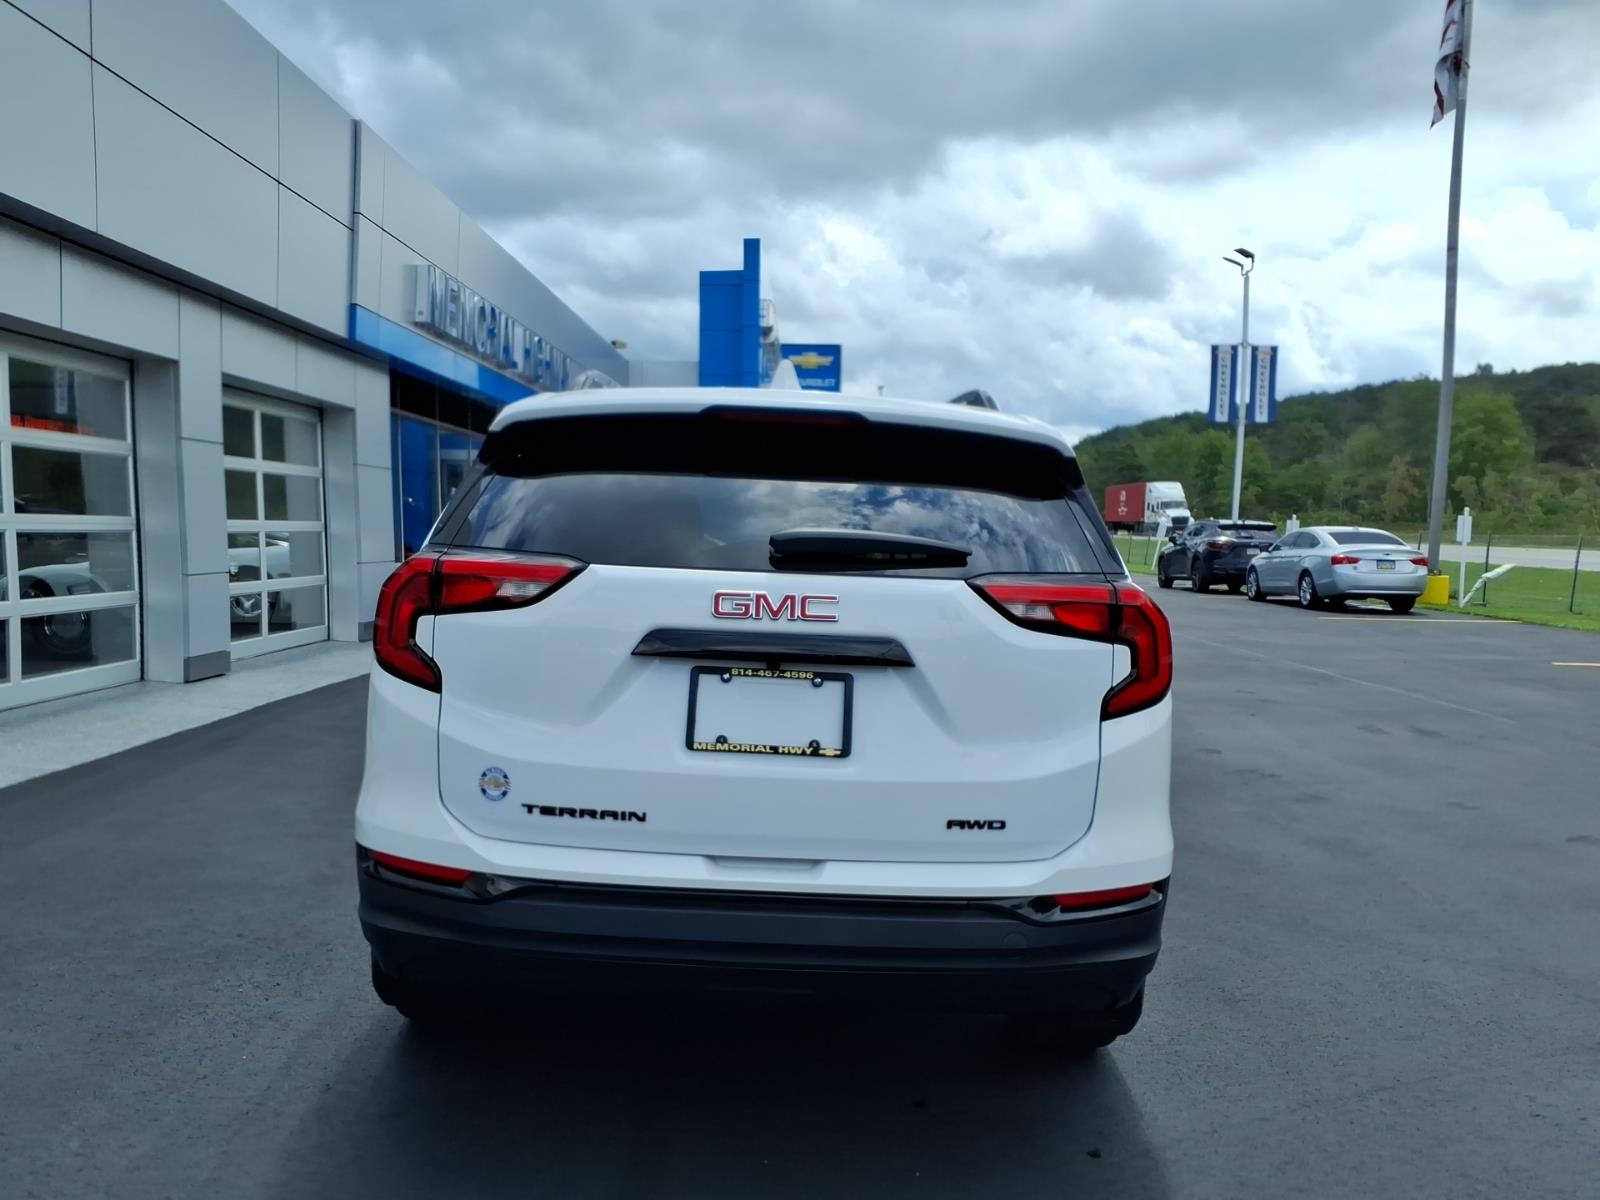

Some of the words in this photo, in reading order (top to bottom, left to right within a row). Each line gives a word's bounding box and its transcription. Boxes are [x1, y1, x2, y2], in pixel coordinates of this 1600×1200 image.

[712, 589, 839, 622] GMC
[731, 668, 814, 680] 814-467-4596
[693, 742, 774, 754] MEMORIAL
[778, 746, 814, 756] HWY
[521, 803, 647, 822] TERRAIN
[946, 819, 1006, 831] AWD
